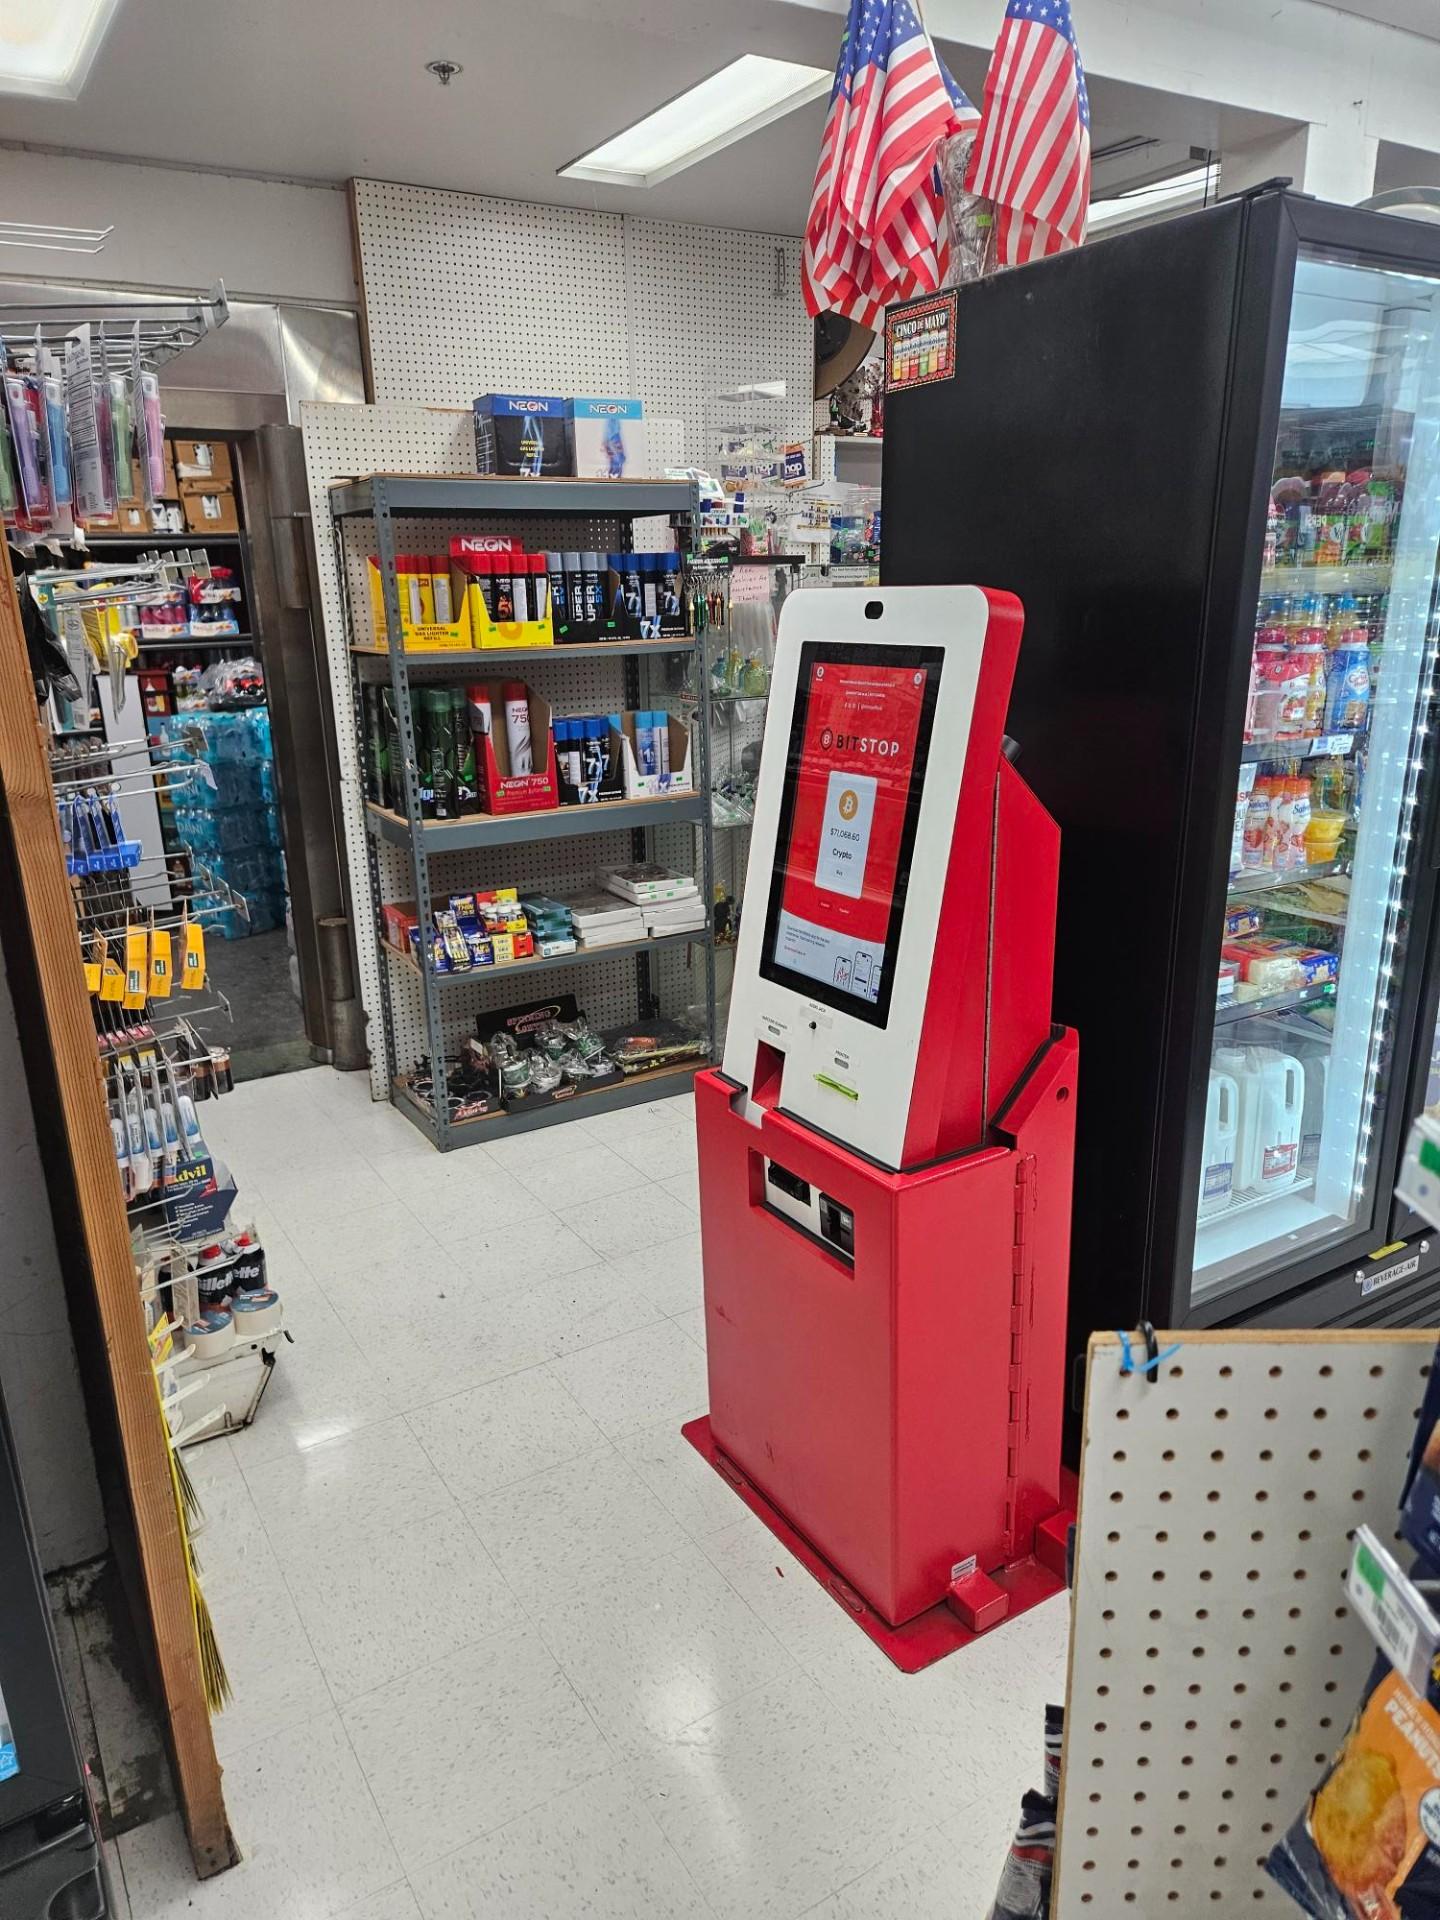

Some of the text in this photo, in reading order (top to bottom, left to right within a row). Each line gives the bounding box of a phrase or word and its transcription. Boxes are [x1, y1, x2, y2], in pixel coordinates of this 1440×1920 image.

[896, 312, 946, 337] CINCO DE MAYO
[509, 401, 548, 411] NEON
[590, 404, 627, 414] NEON
[461, 539, 512, 552] NEON
[836, 734, 899, 757] BITSTOP
[500, 777, 549, 789] NEON 750
[833, 848, 852, 860] Crypto
